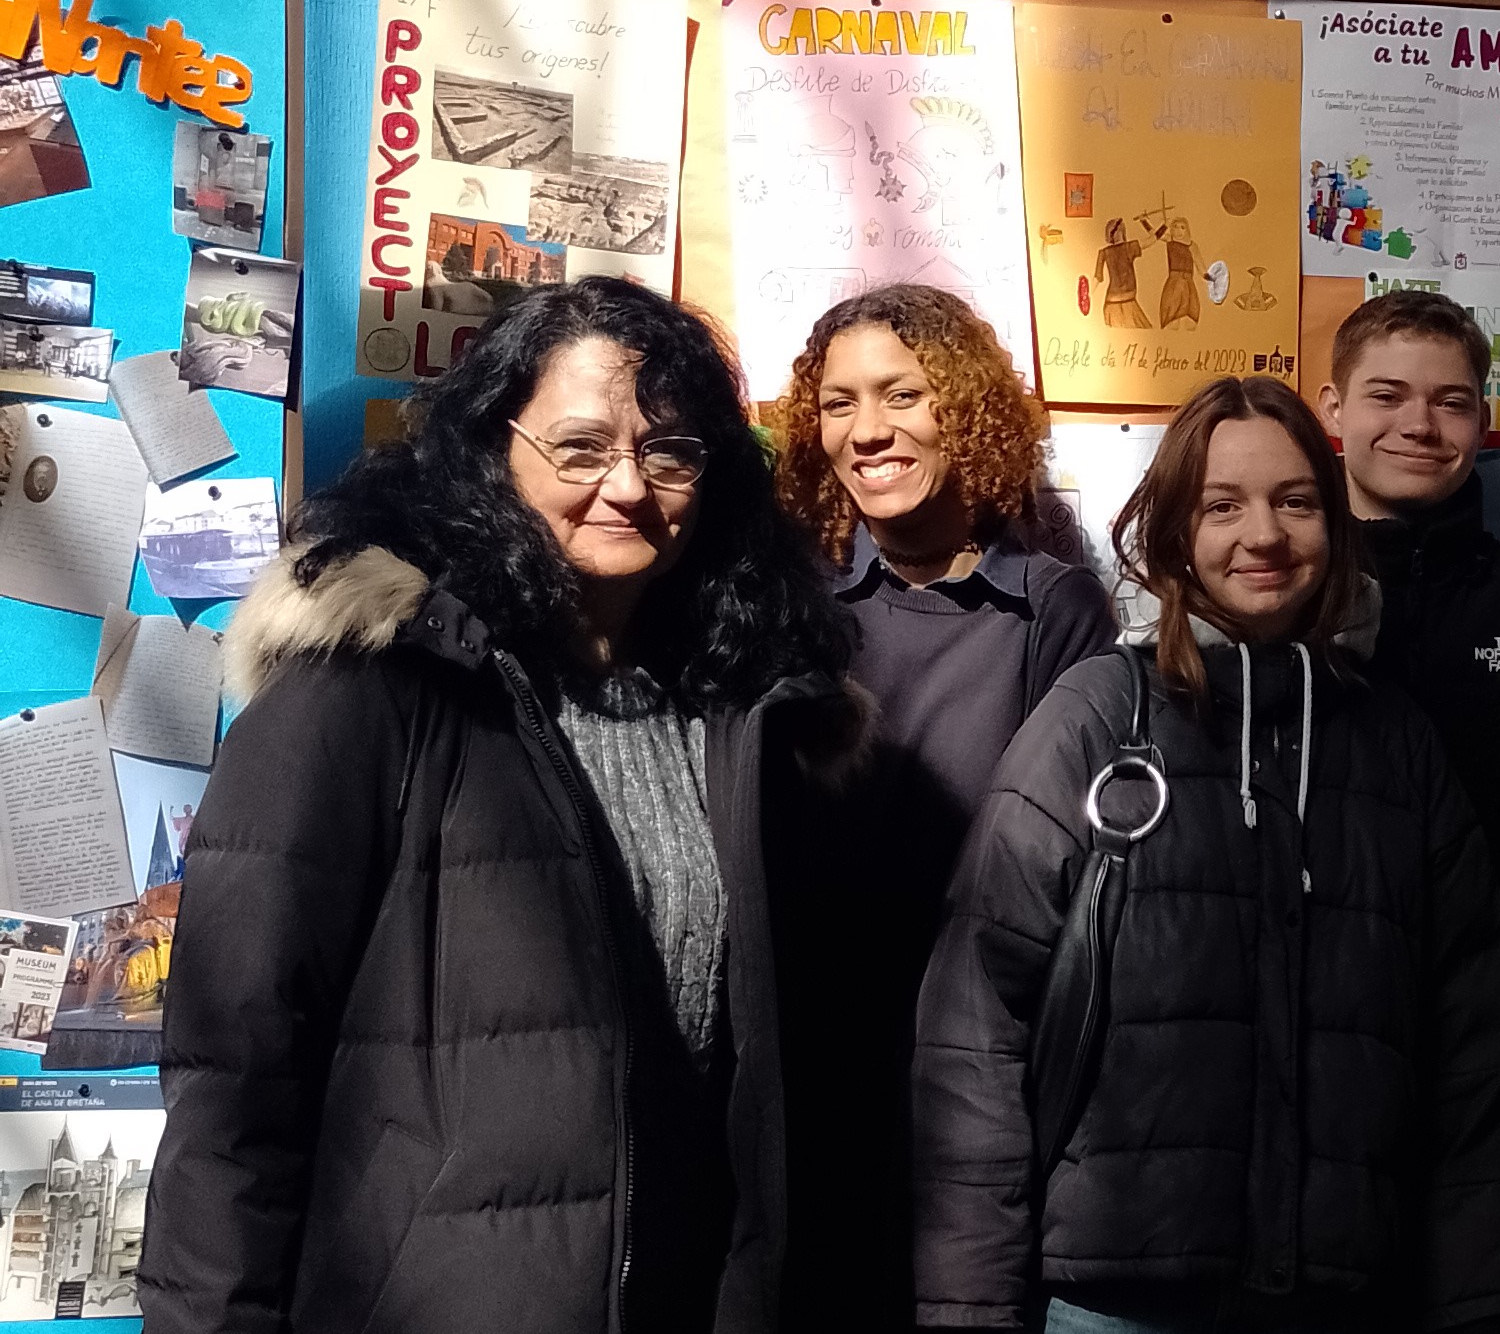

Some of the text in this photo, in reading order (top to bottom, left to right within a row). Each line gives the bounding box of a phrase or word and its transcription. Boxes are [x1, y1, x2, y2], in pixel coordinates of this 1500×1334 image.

[758, 3, 976, 57] CARNAVAL
[1319, 10, 1444, 40] ¡Asóciate
[466, 26, 510, 59] tus
[1374, 44, 1392, 64] a
[1400, 43, 1431, 65] tu
[851, 69, 874, 93] de
[1425, 73, 1443, 90] Por
[1446, 84, 1485, 99] muchos
[15, 956, 57, 970] MUSEUM
